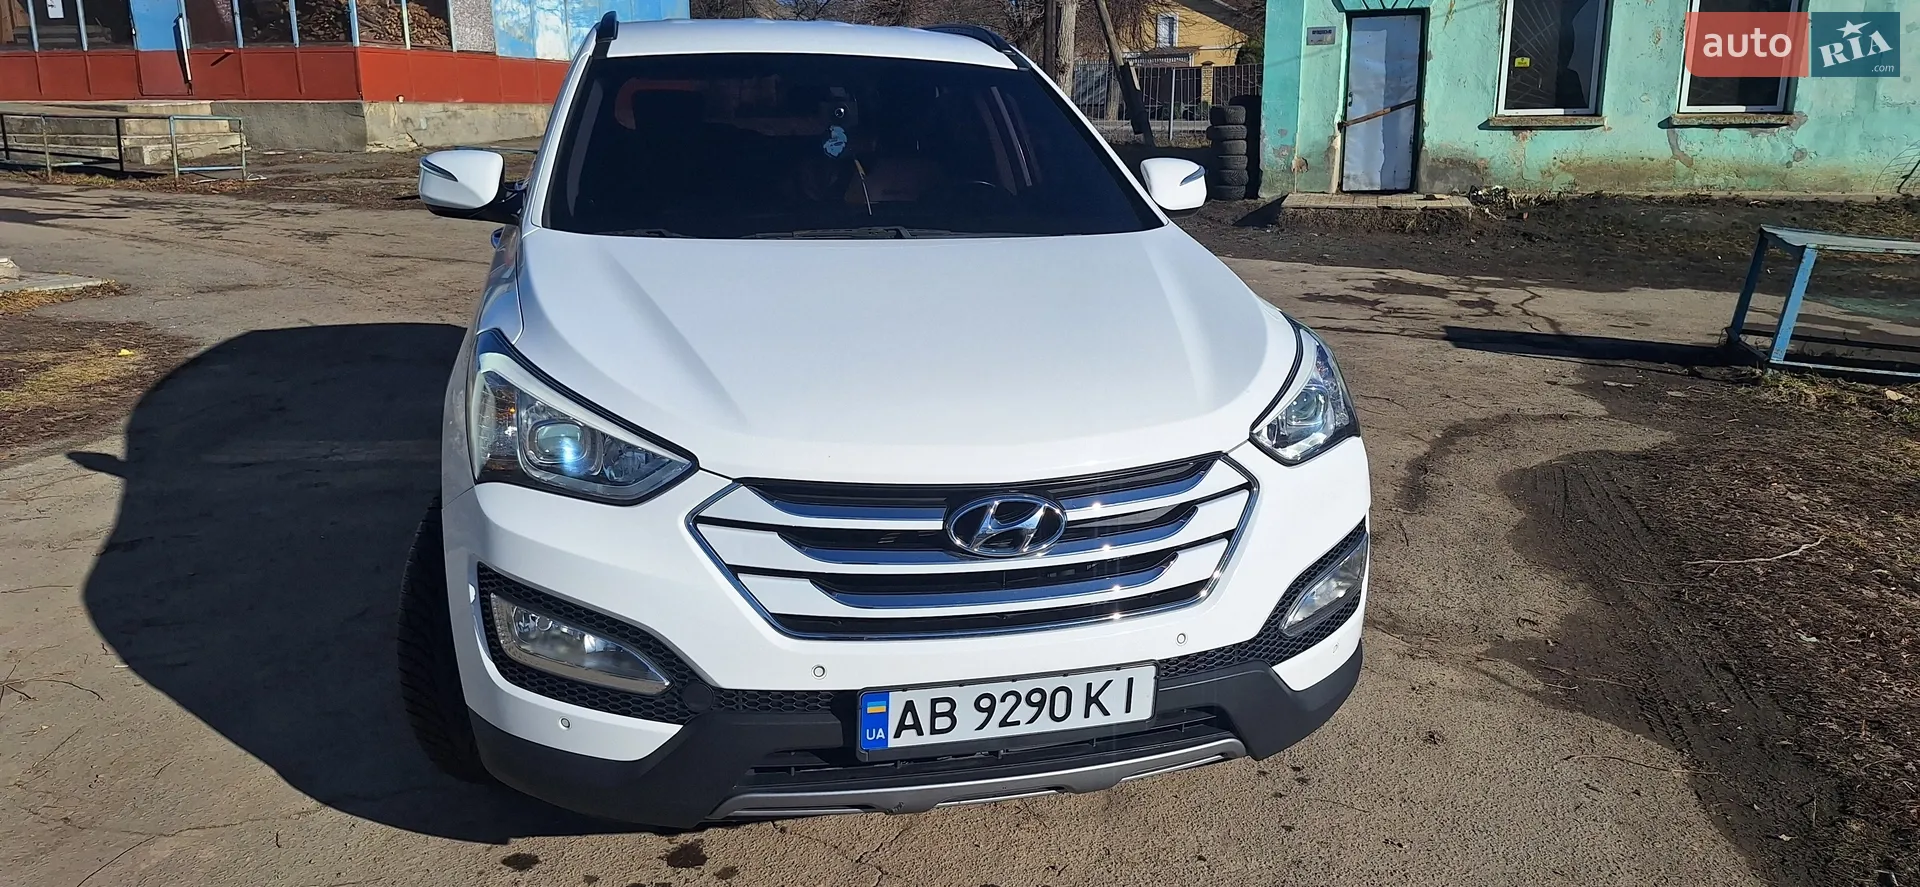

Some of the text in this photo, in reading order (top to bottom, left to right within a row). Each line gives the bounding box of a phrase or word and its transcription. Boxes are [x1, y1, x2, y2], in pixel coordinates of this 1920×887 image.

[893, 697, 957, 739] AB
[973, 686, 1073, 731] 9290
[866, 728, 886, 741] UA
